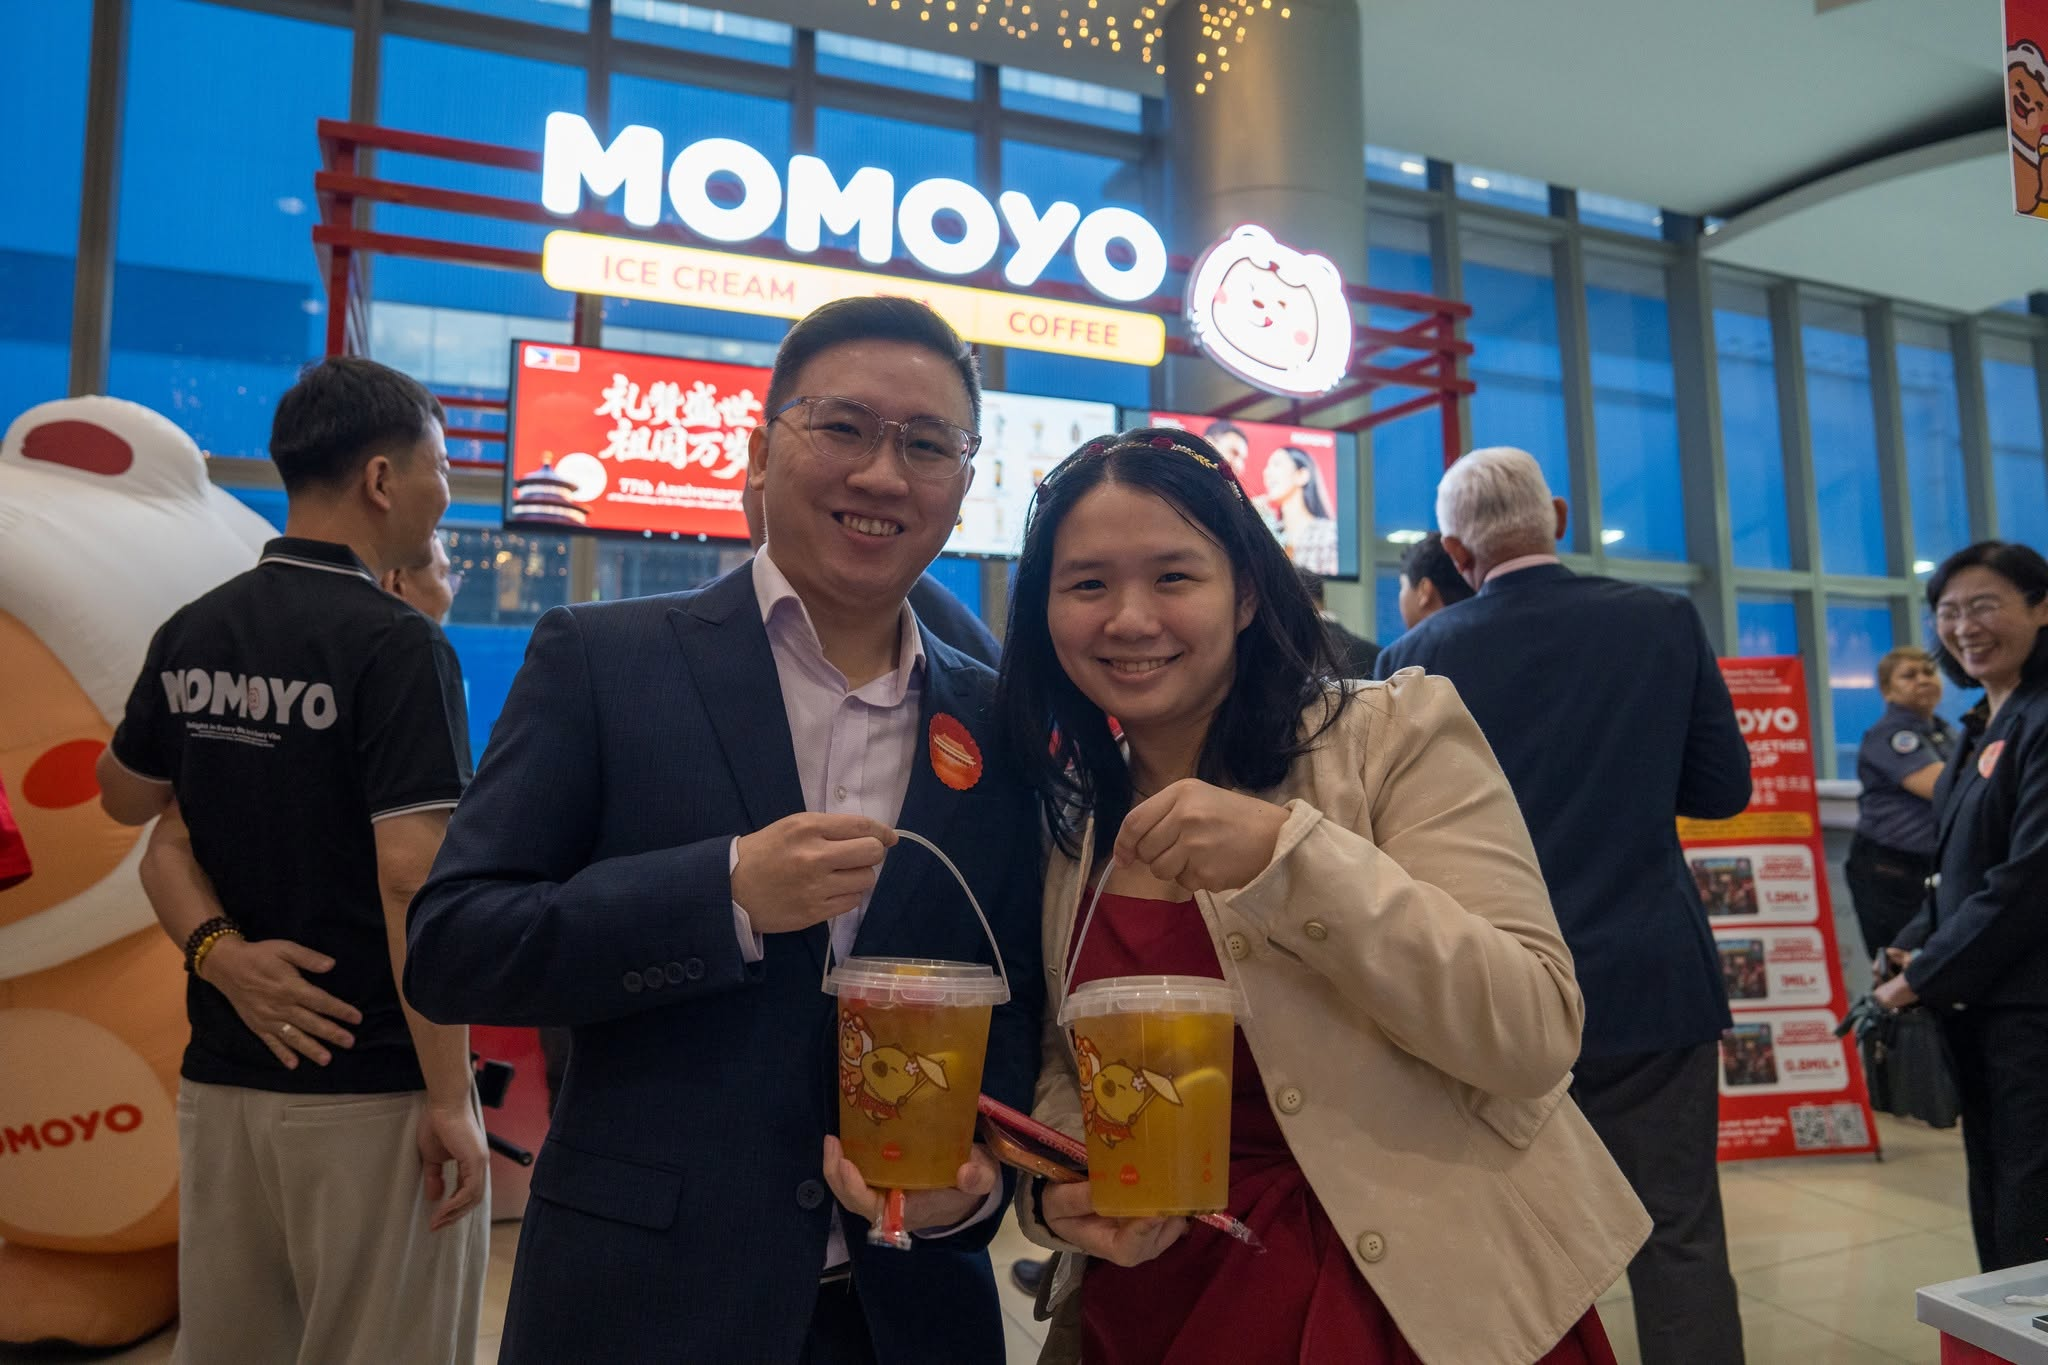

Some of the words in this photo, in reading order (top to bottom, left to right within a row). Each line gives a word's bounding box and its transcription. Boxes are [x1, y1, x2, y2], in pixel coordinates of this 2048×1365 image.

[542, 111, 1167, 301] MOMOYO
[603, 255, 657, 285] ICE
[673, 265, 796, 304] CREAM
[1009, 311, 1119, 346] COFFEE
